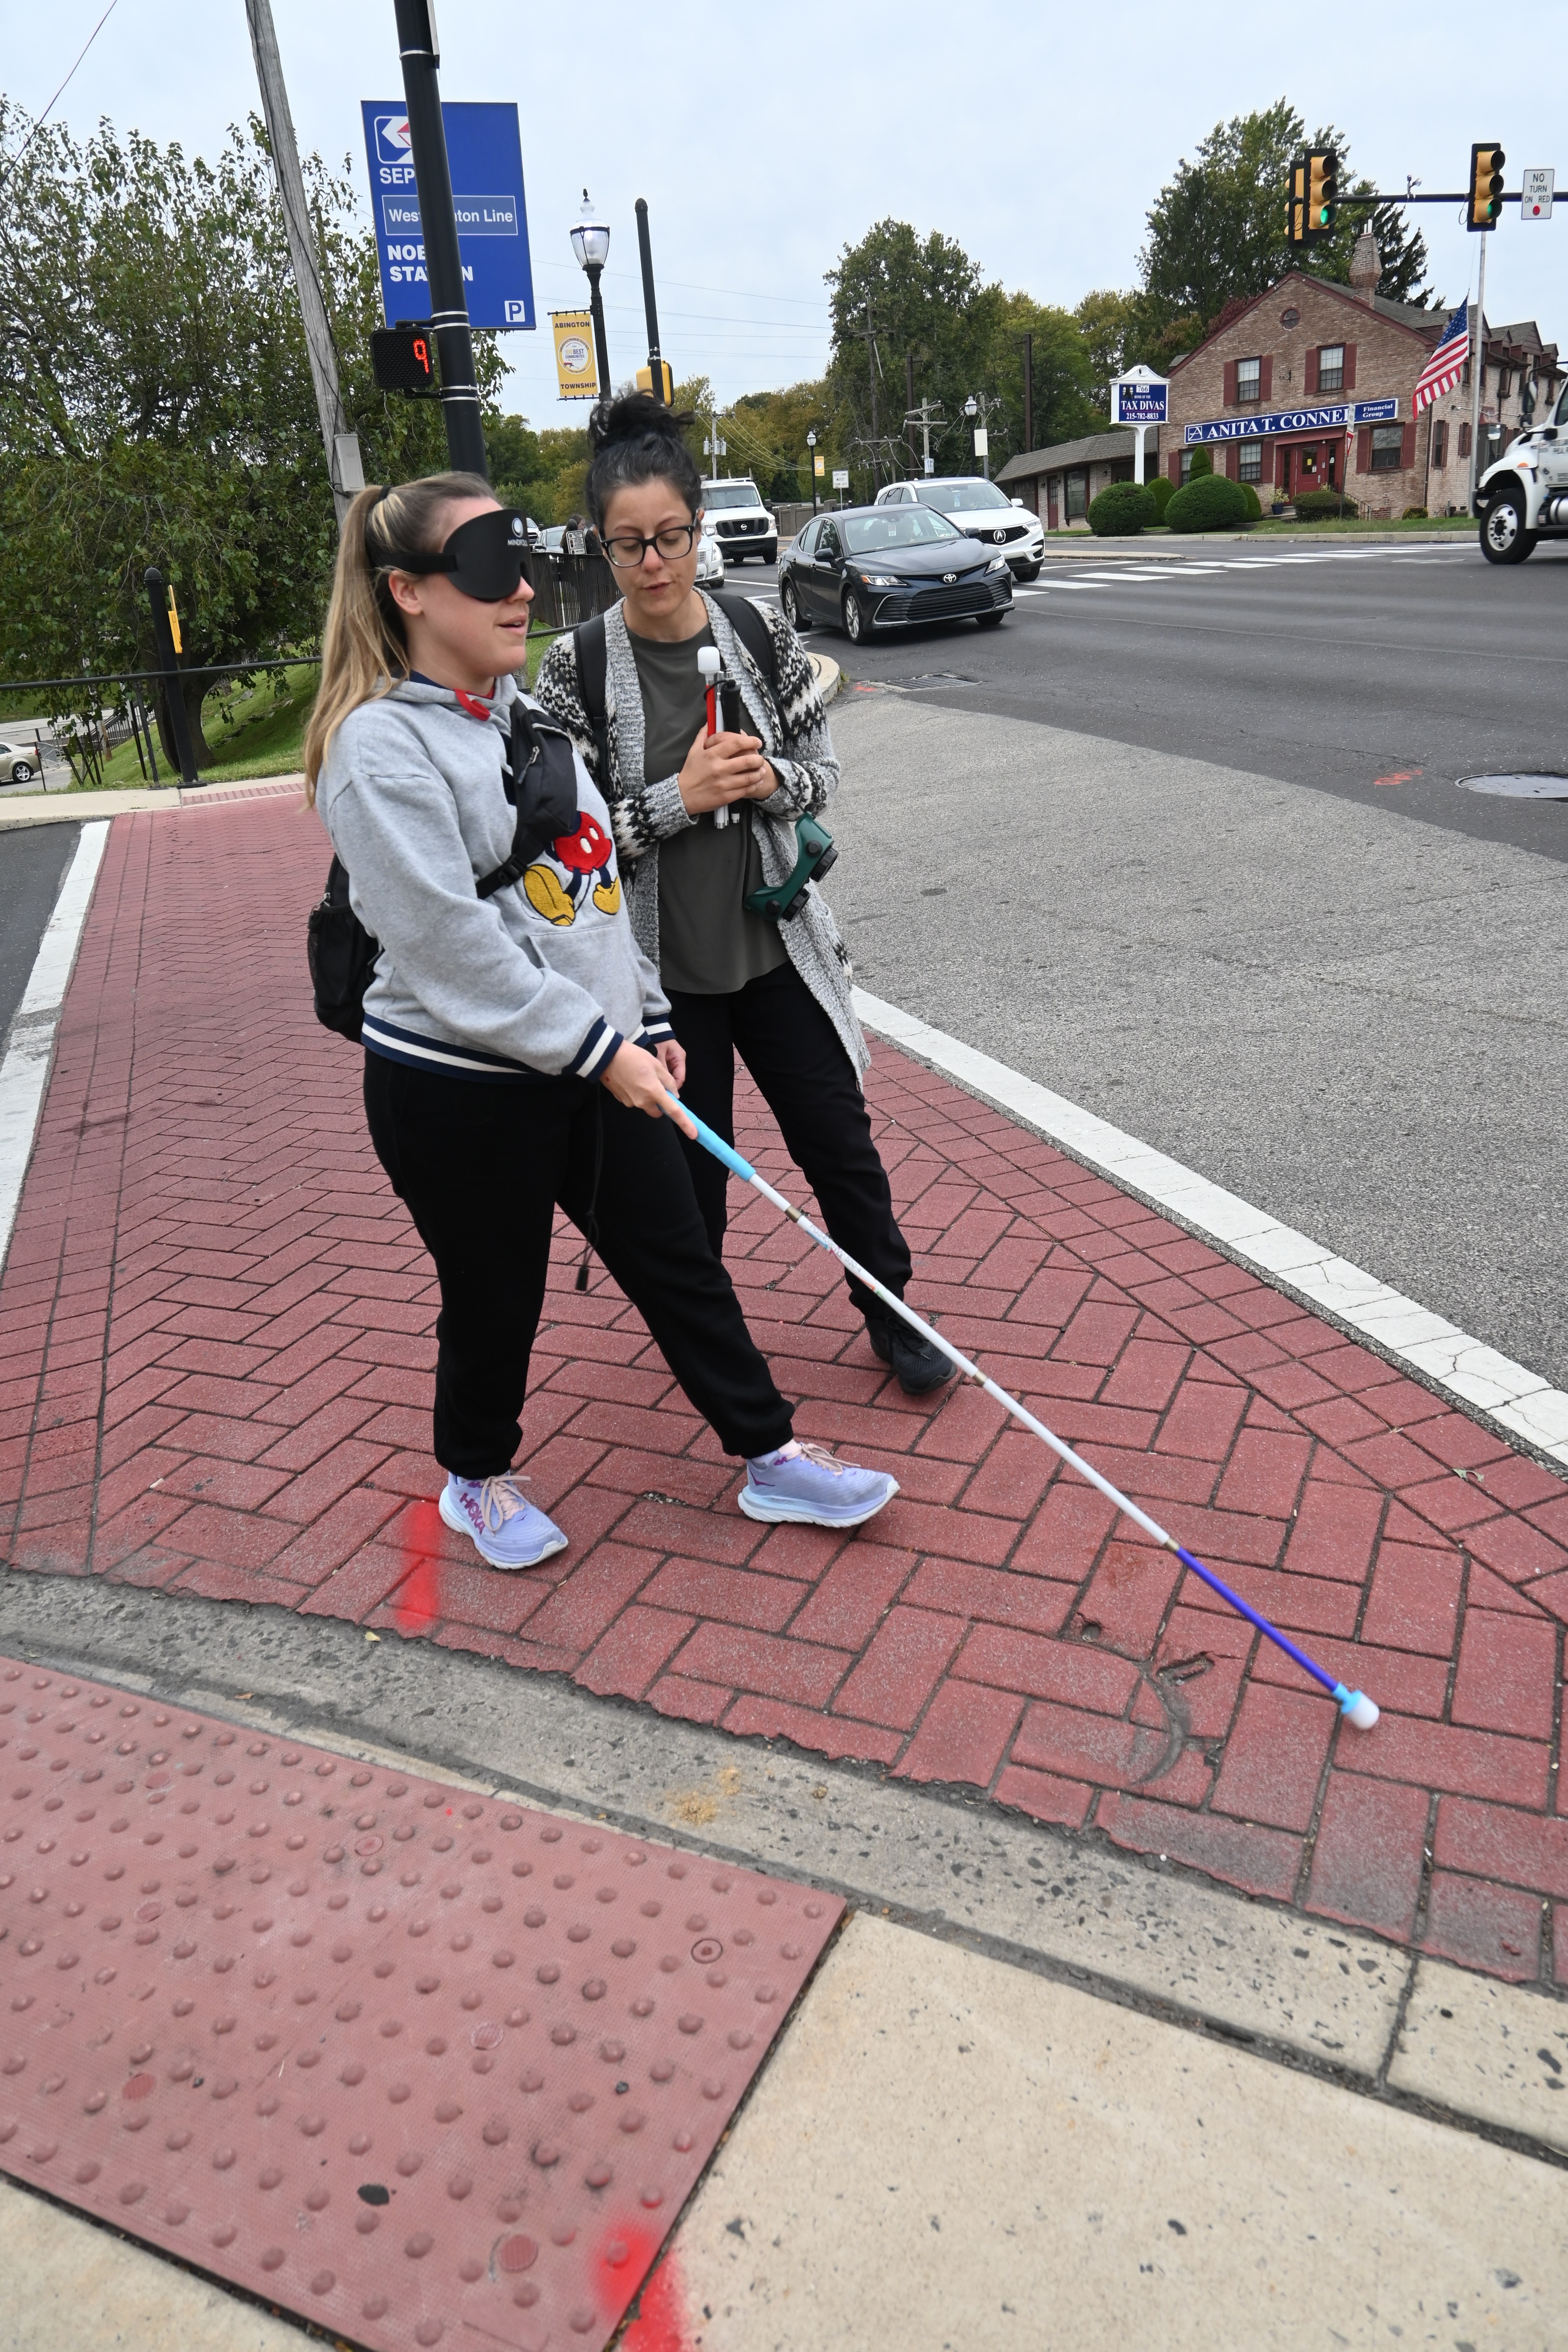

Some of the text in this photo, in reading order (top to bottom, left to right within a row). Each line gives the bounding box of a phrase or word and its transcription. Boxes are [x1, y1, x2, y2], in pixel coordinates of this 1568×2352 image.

[380, 168, 415, 184] SEP
[1533, 173, 1544, 182] NO
[1529, 185, 1547, 193] TURN
[1538, 195, 1550, 203] RED
[389, 209, 420, 222] Wes
[484, 209, 513, 222] Line
[389, 266, 473, 282] STAN
[508, 302, 522, 320] P
[413, 339, 429, 373] 9
[1121, 401, 1164, 410] TAX DIVAS
[1363, 403, 1393, 412] Financial
[1207, 420, 1258, 438] ANITA
[1262, 418, 1275, 431] T.
[459, 1492, 485, 1535] HOKA
